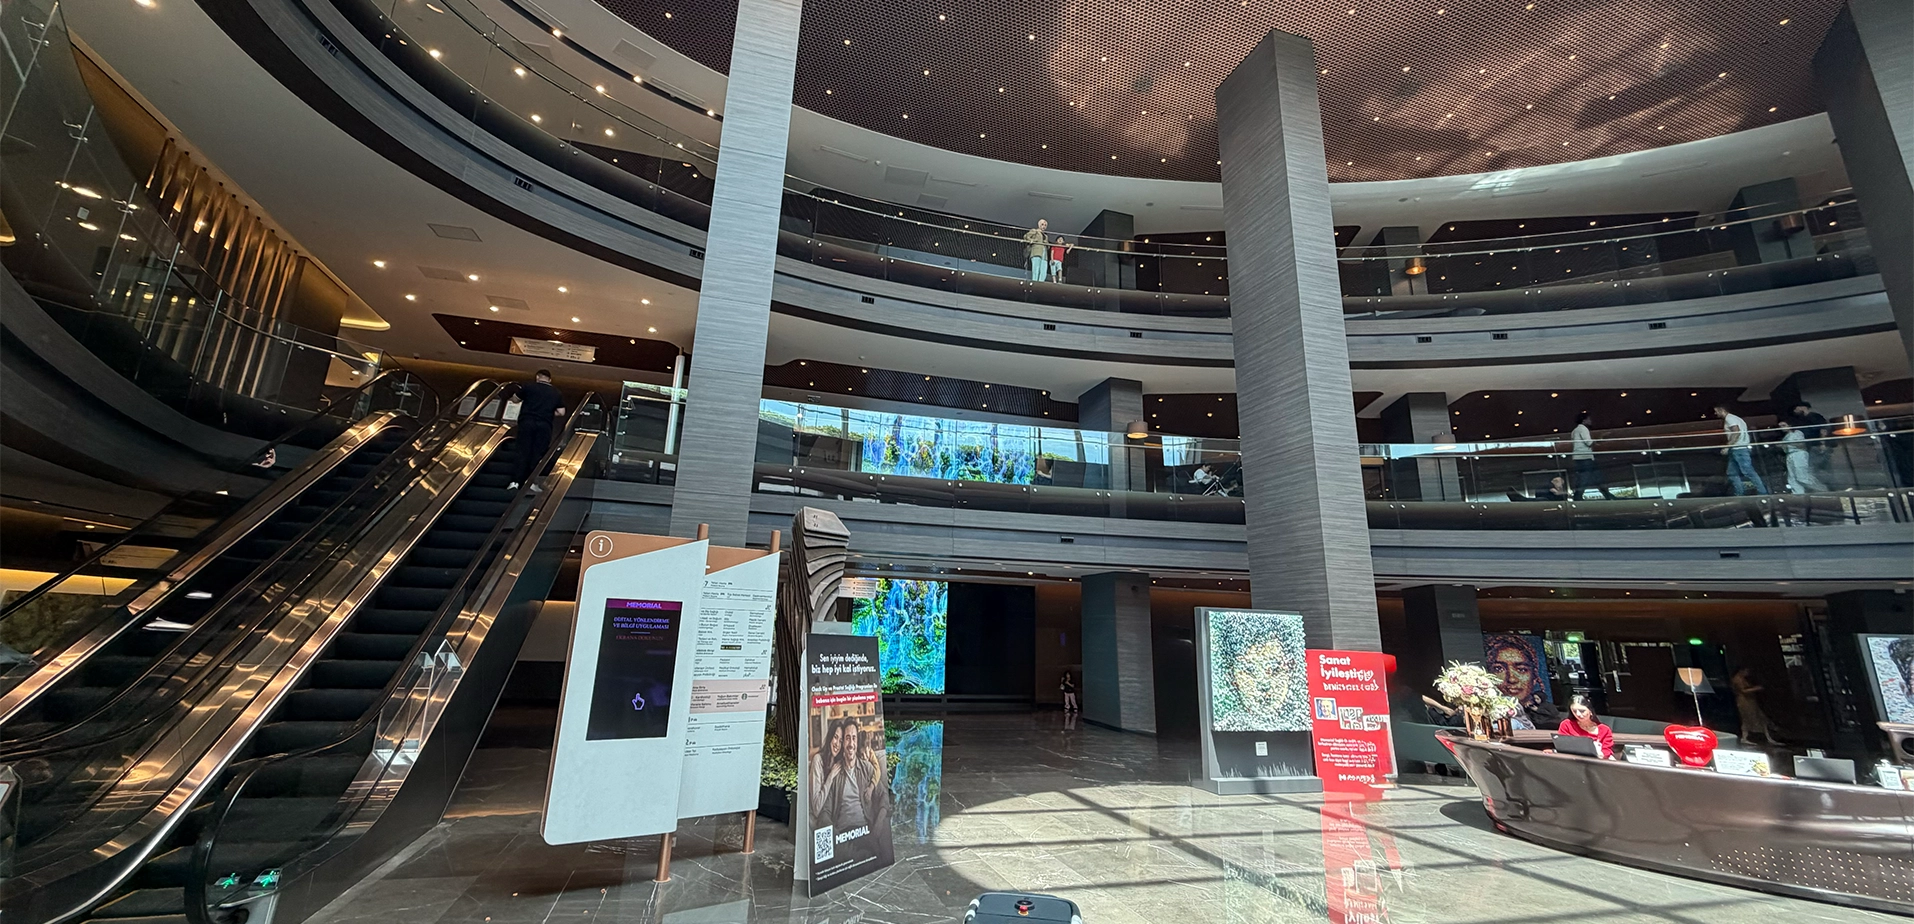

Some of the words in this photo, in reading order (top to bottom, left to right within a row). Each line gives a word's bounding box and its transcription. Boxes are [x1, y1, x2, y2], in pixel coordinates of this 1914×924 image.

[626, 601, 662, 609] MEMORIAL
[820, 653, 829, 662] Sen
[1319, 654, 1350, 665] Sanat
[811, 664, 821, 674] biz
[821, 664, 833, 676] hep
[834, 664, 842, 675] iyi
[842, 664, 852, 673] kal
[835, 825, 870, 844] MEMORIAL
